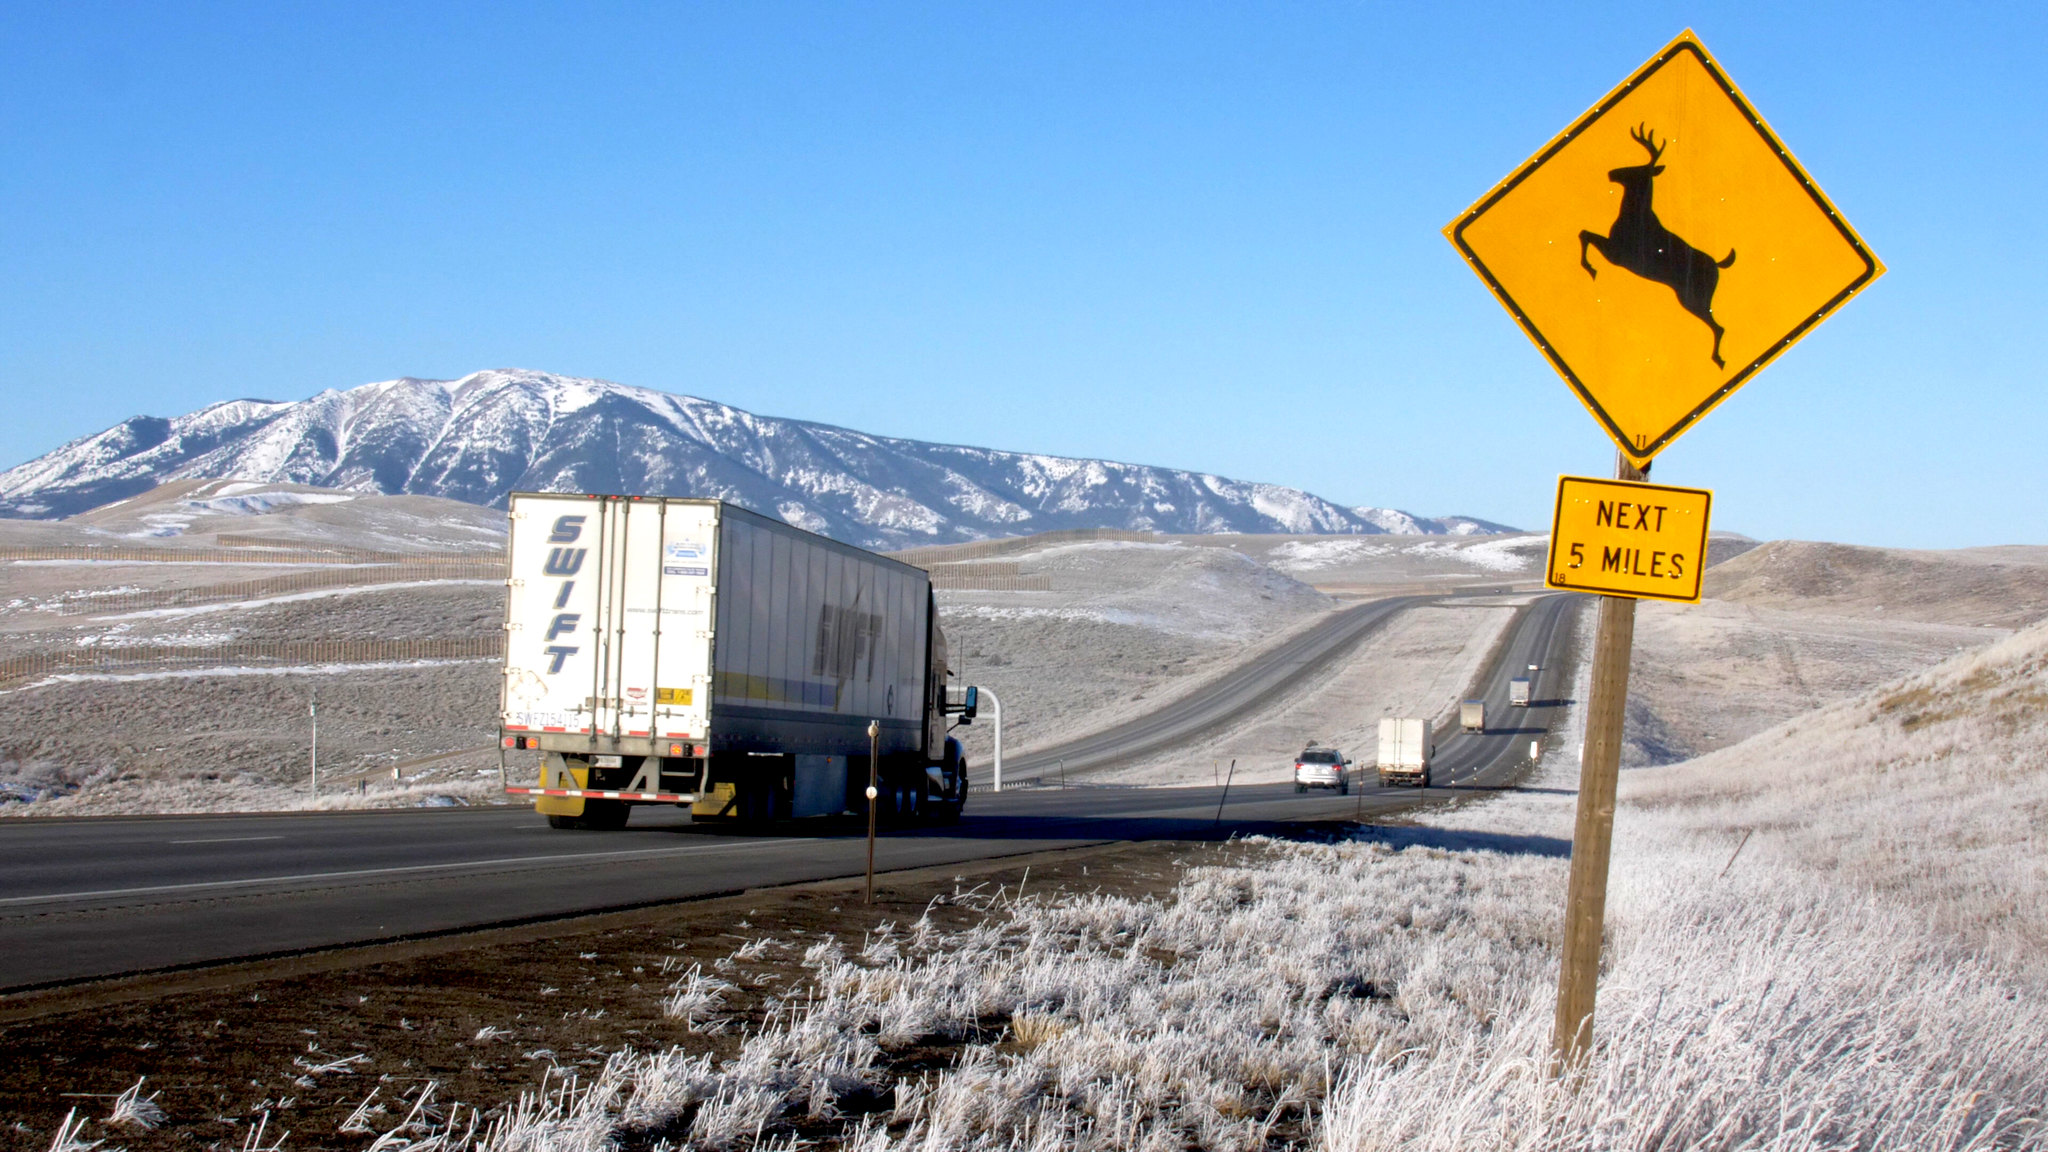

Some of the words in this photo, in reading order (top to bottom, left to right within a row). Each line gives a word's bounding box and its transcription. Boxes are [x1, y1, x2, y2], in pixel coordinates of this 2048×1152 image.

[1596, 500, 1668, 532] NEXT
[1568, 542, 1585, 569] 5
[1601, 546, 1685, 579] MILES
[542, 515, 588, 675] SWIFT
[1554, 572, 1566, 585] 18
